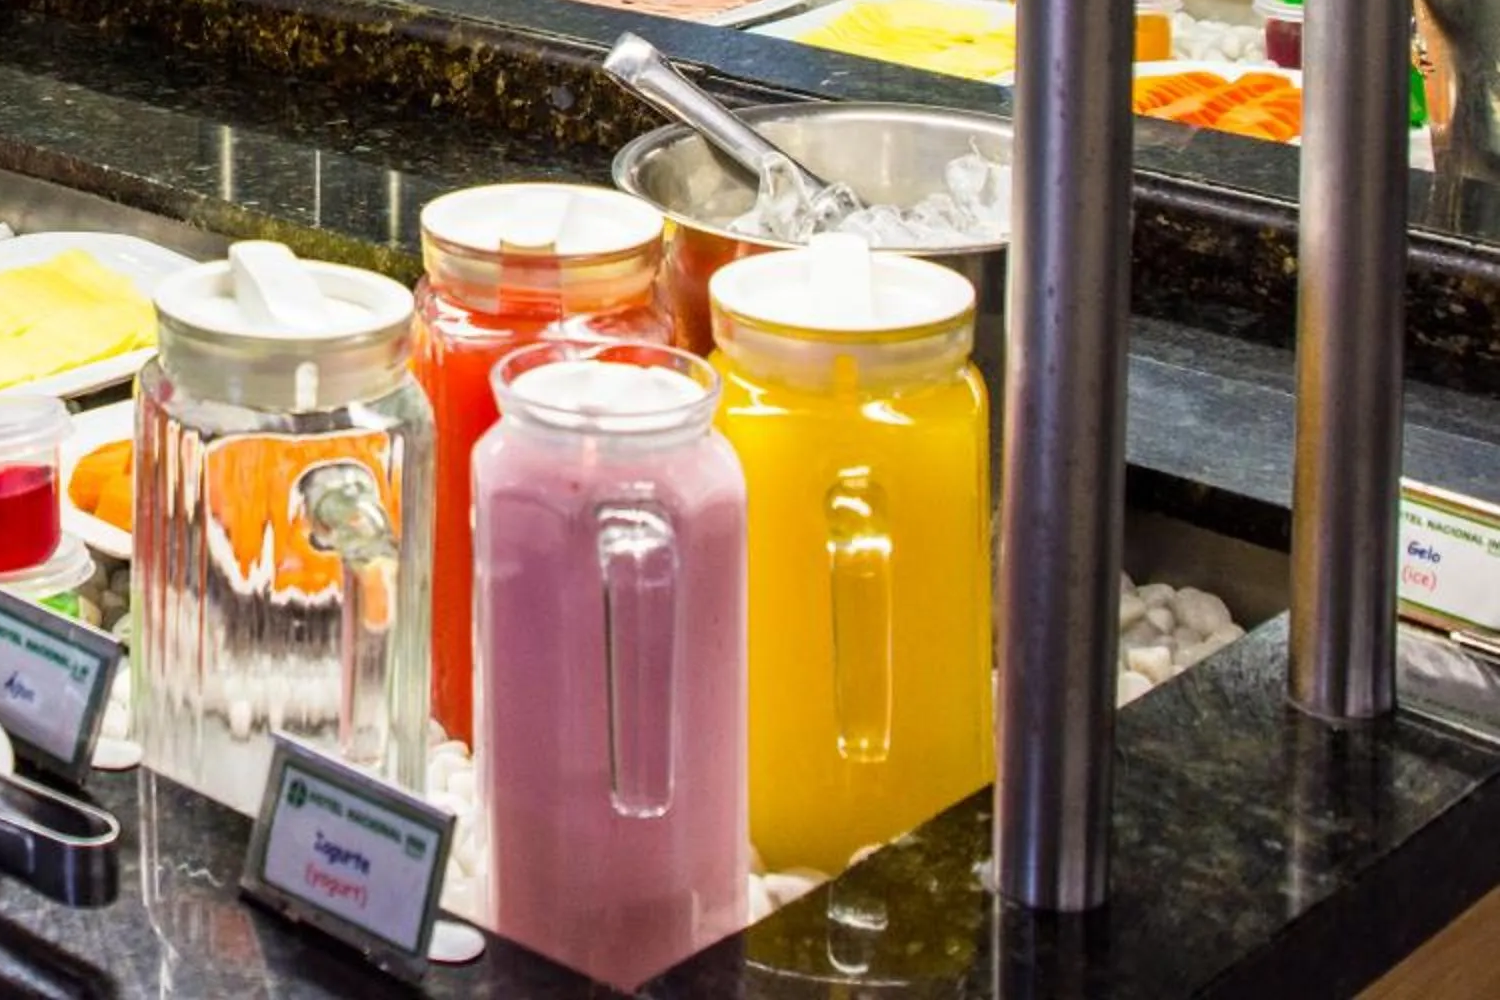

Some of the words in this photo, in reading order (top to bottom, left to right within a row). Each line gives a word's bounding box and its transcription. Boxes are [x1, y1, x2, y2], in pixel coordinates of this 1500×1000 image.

[1405, 511, 1422, 526] TEL
[1427, 520, 1483, 545] NACIONAL
[1407, 541, 1441, 563] Gelo
[1402, 565, 1437, 591] (ice)
[314, 829, 370, 874] Iogurte
